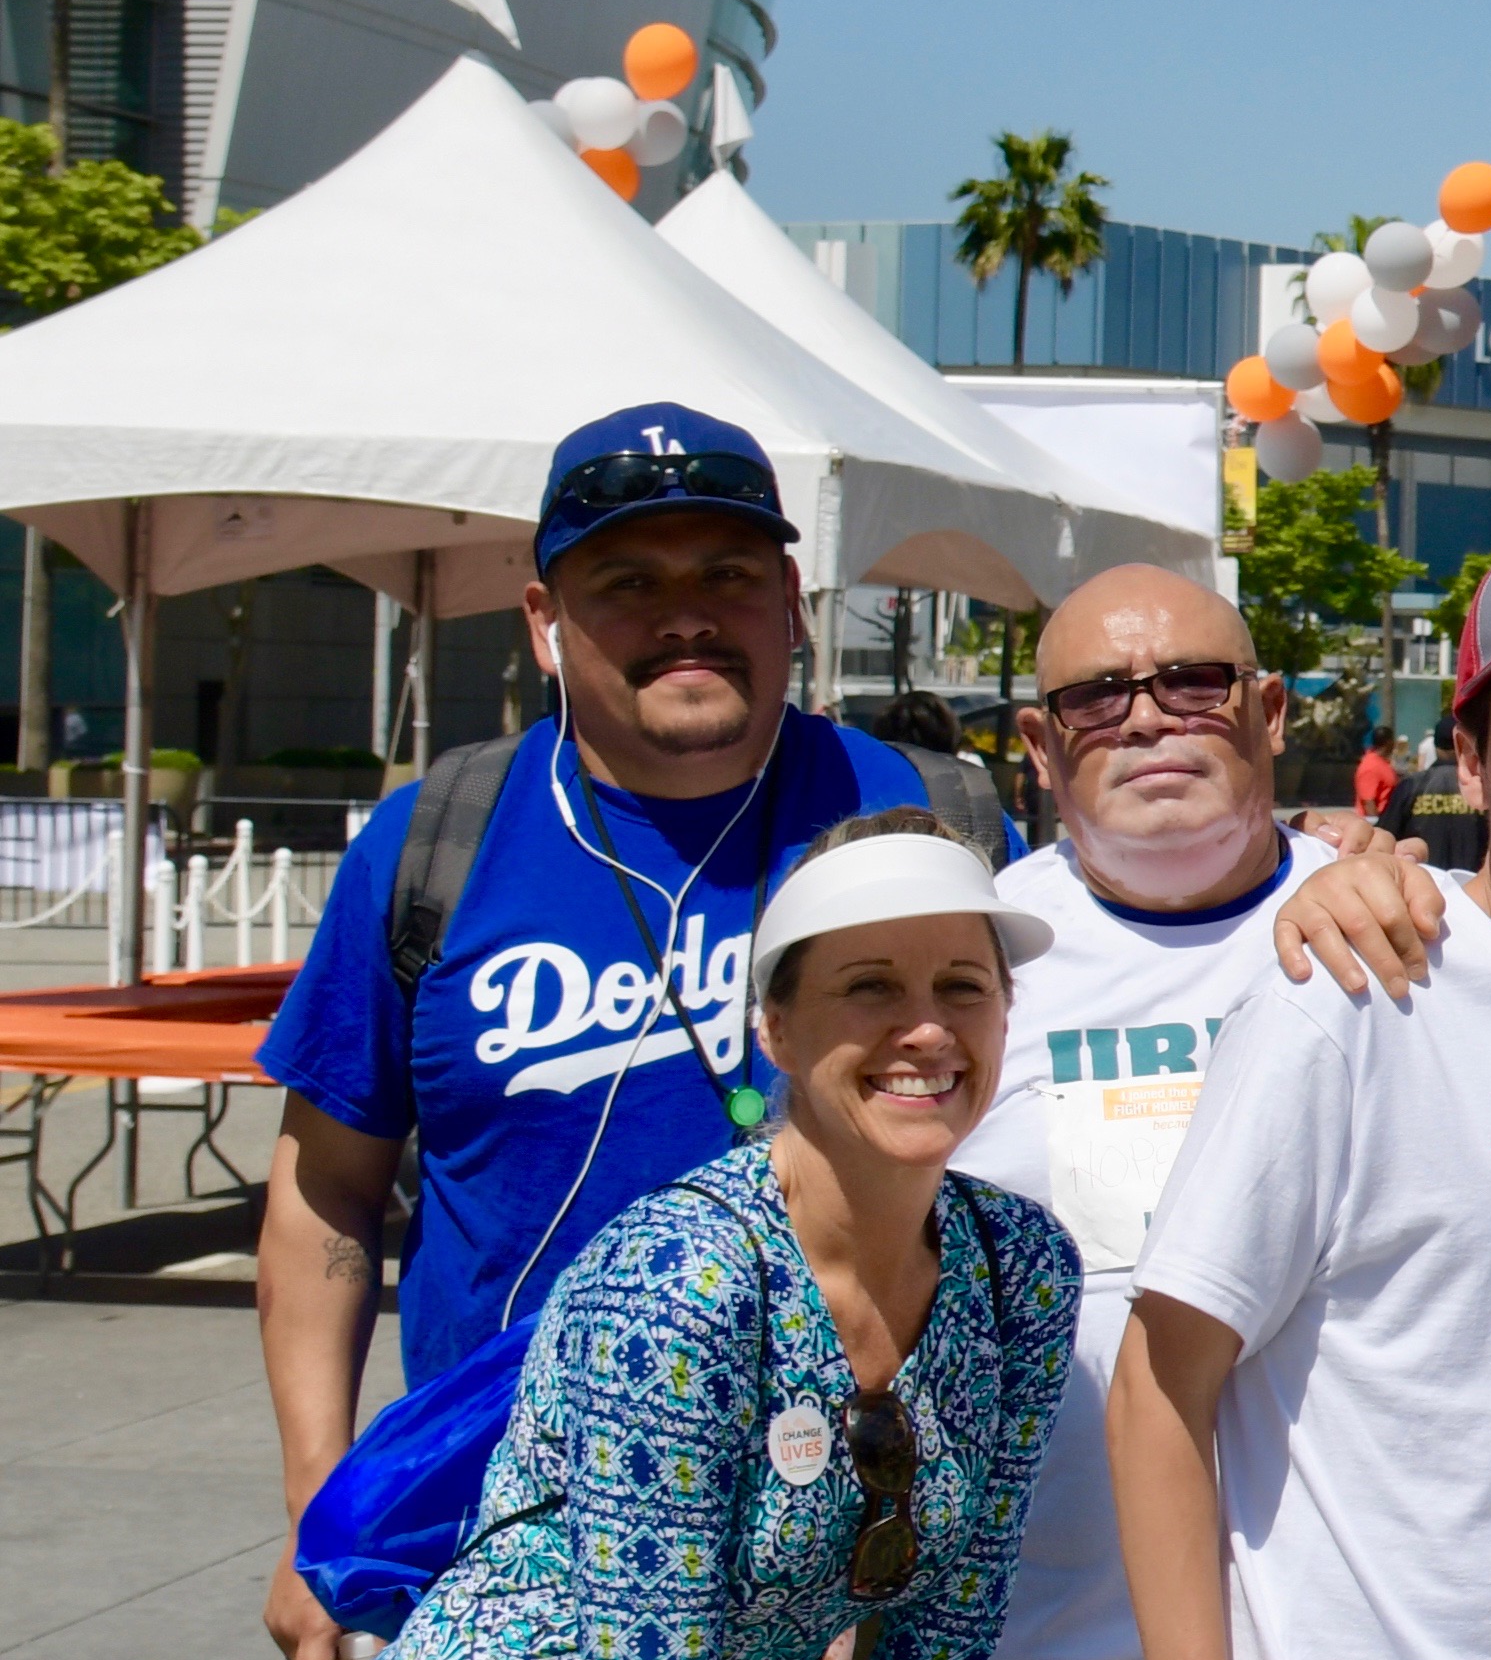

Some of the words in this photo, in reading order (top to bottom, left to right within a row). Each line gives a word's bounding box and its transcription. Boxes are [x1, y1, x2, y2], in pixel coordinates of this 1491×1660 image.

[1047, 1017, 1225, 1084] UR
[1128, 1089, 1168, 1102] joined
[1170, 1088, 1188, 1098] the
[1114, 1103, 1150, 1116] FIGHT
[782, 1427, 823, 1442] CHANGE
[780, 1440, 823, 1462] LIVES
